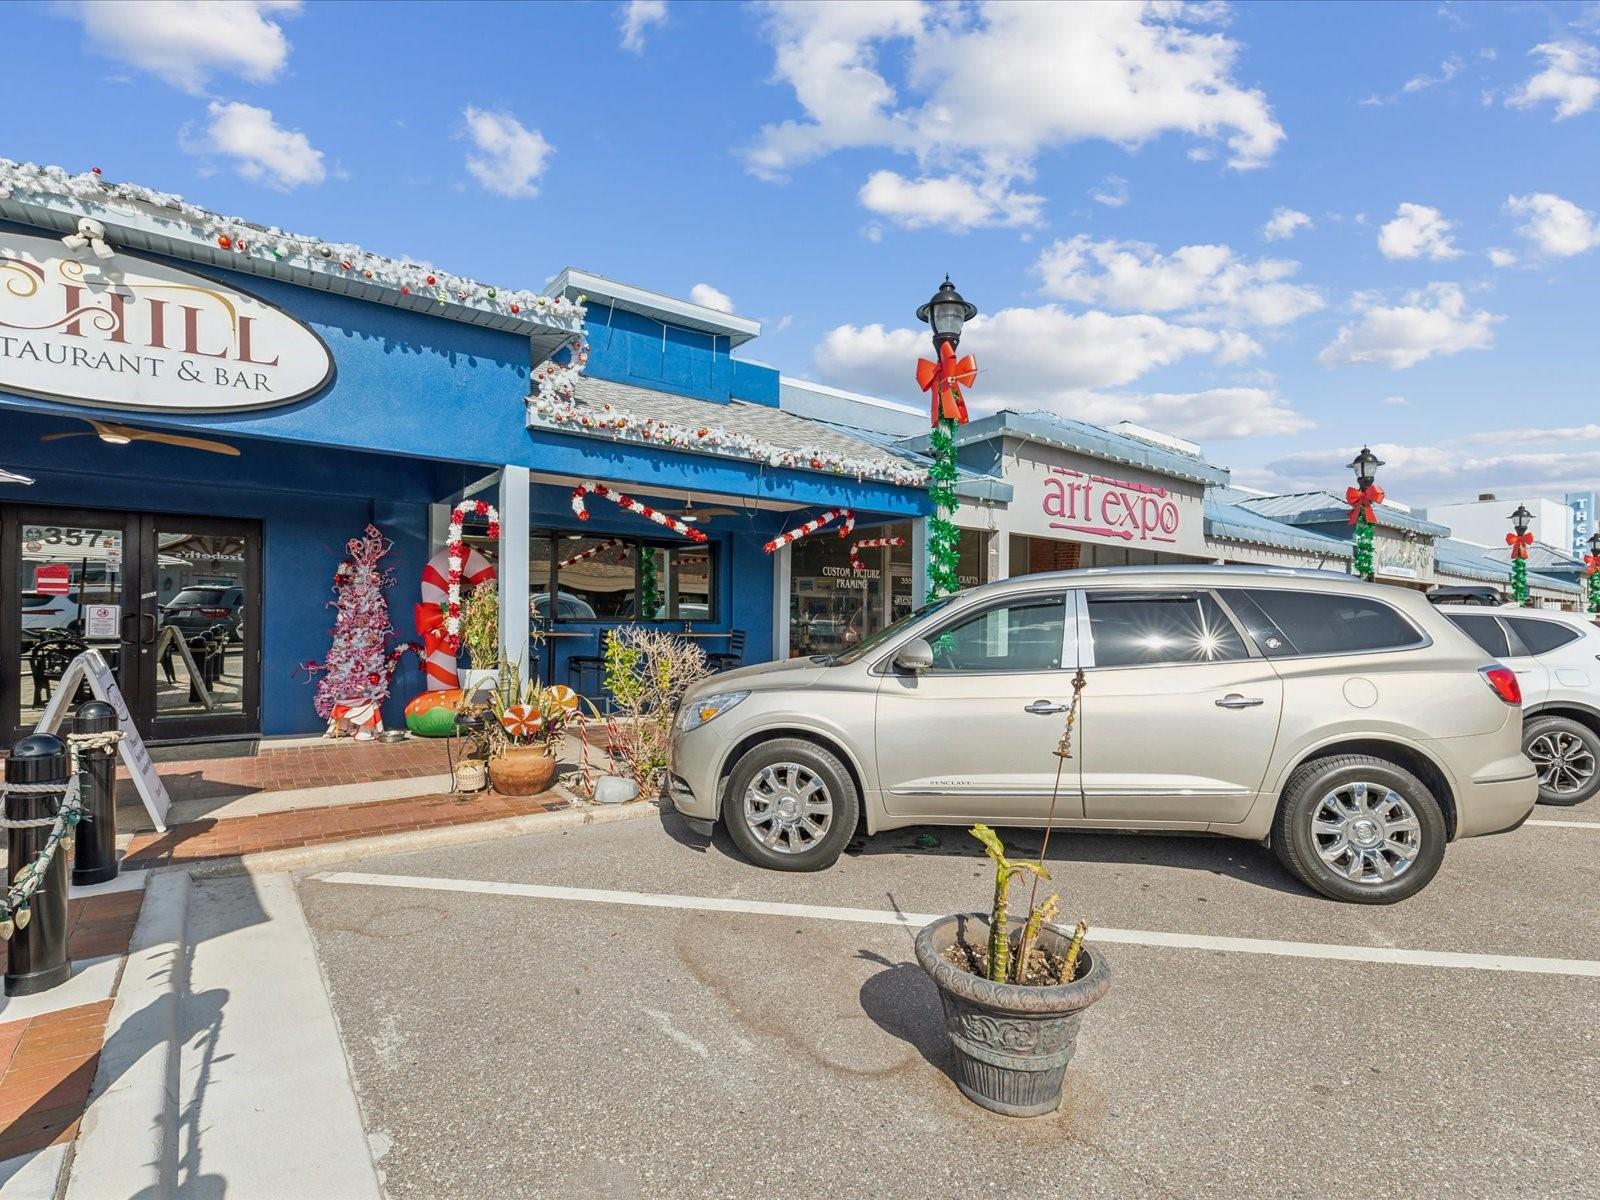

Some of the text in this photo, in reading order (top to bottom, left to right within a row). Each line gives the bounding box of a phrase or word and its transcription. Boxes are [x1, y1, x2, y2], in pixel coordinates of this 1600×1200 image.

[177, 360, 205, 383] &
[215, 367, 273, 392] BAR
[1042, 475, 1179, 540] art expo
[44, 527, 103, 548] 357
[822, 566, 880, 579] CUSTOM PICTURE
[836, 578, 867, 589] FRAMING
